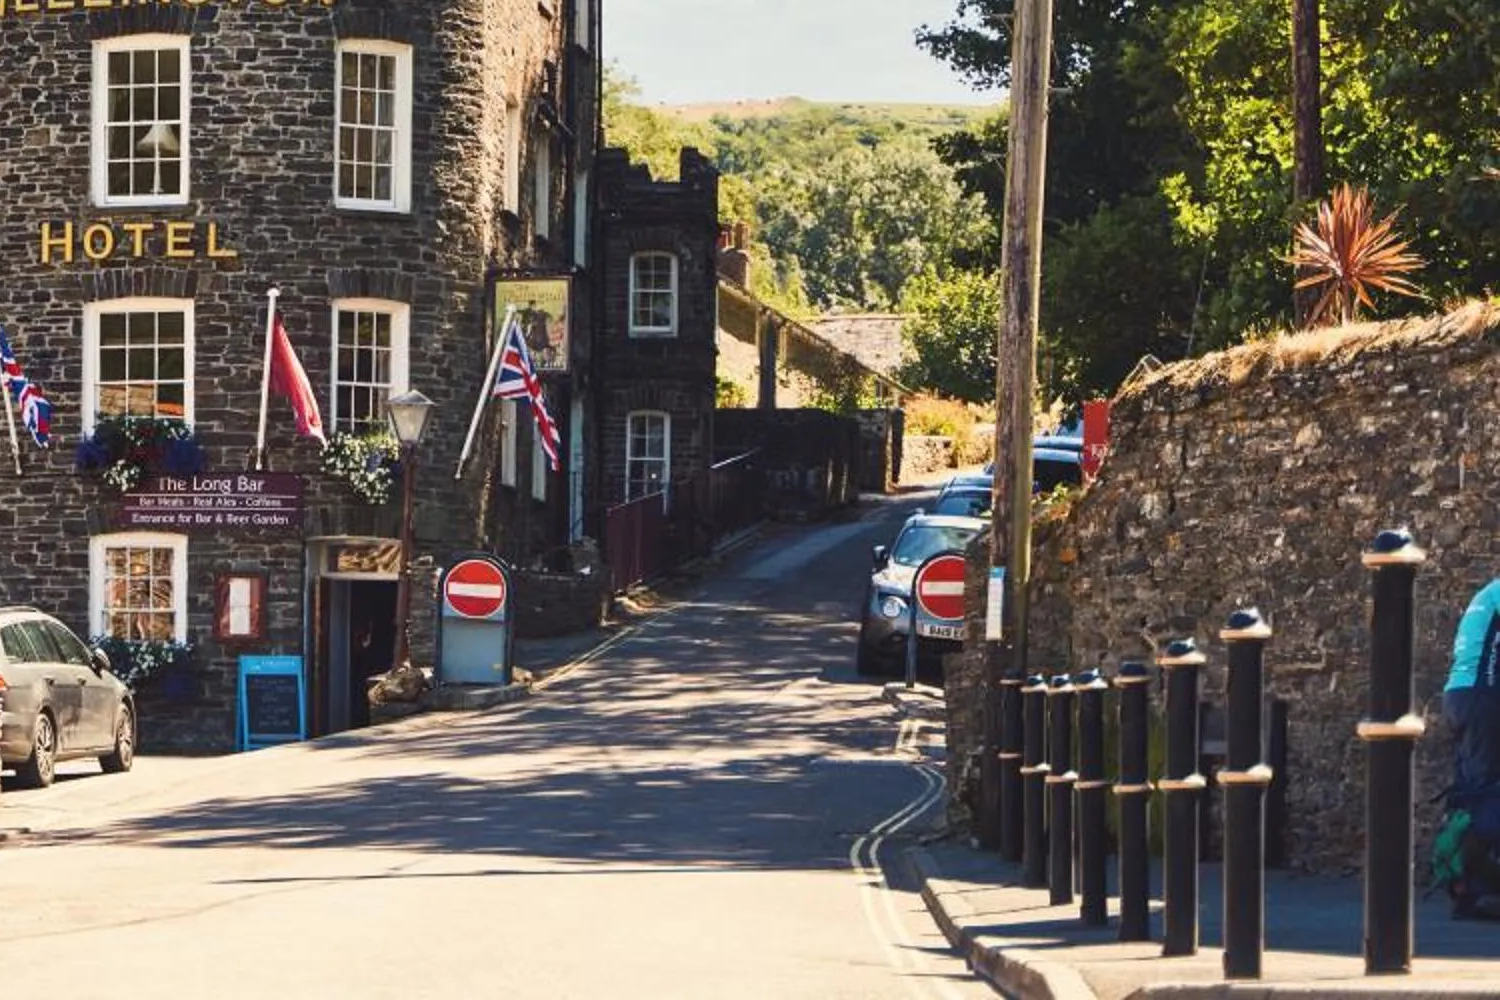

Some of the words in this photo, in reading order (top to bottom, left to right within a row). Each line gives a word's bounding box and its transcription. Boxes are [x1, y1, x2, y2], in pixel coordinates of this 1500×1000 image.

[40, 220, 238, 264] HOTEL
[159, 476, 188, 491] The
[193, 476, 232, 494] Long
[237, 475, 266, 492] Bar
[251, 513, 289, 525] Garden
